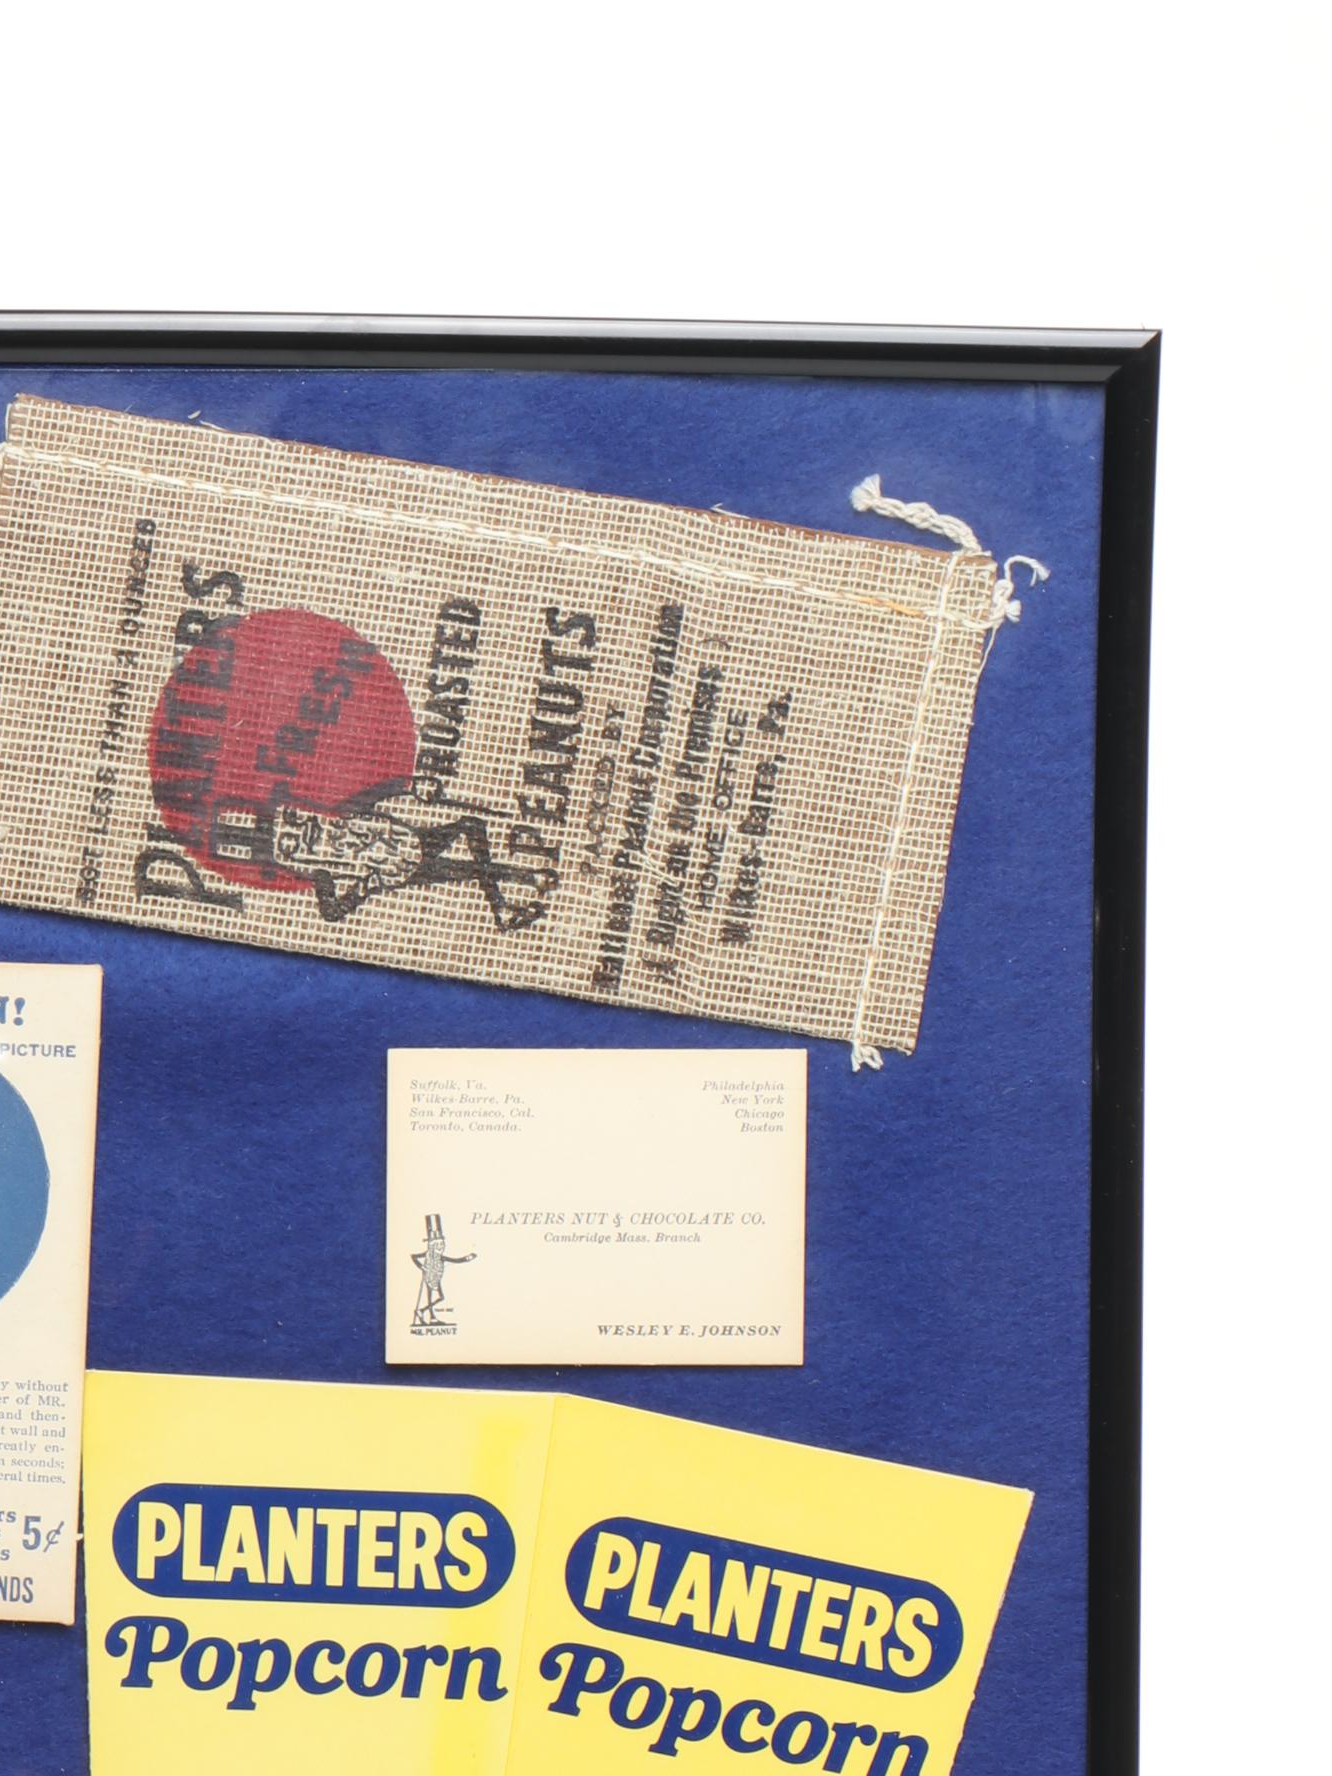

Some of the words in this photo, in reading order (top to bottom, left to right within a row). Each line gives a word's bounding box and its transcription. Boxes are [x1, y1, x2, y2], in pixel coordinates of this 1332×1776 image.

[425, 597, 482, 787] ROASTED
[256, 638, 378, 777] FRESH
[510, 605, 598, 865] PEANUTS
[603, 703, 626, 741] BY
[135, 561, 247, 913] PLANTERS
[699, 828, 725, 912] HOME
[714, 710, 749, 813] OFFICE
[0, 1043, 76, 1058] PICTURE
[409, 1079, 461, 1092] Suffolk,
[466, 1079, 487, 1090] Va.
[702, 1080, 785, 1093] Philadelphia
[720, 1094, 748, 1105] New
[753, 1094, 785, 1105] York
[734, 1108, 785, 1120] Chicago
[740, 1122, 784, 1133] Boston
[470, 1212, 565, 1225] PLANTERS
[570, 1212, 609, 1225] NUT
[612, 1213, 623, 1228] &
[630, 1212, 735, 1225] CHOCOLATE
[740, 1212, 766, 1225] CO.
[543, 1232, 611, 1244] Cambridge
[615, 1232, 650, 1243] Mass.
[654, 1232, 701, 1243] Branch
[597, 1325, 675, 1337] WESLEY
[678, 1325, 695, 1337] E.
[699, 1325, 782, 1338] JOHNSON
[15, 1379, 69, 1392] without
[22, 1515, 65, 1553] 5¢
[135, 1501, 489, 1593] PLANTERS
[582, 1531, 940, 1678] PLANTERS
[104, 1615, 509, 1711] Popcorn
